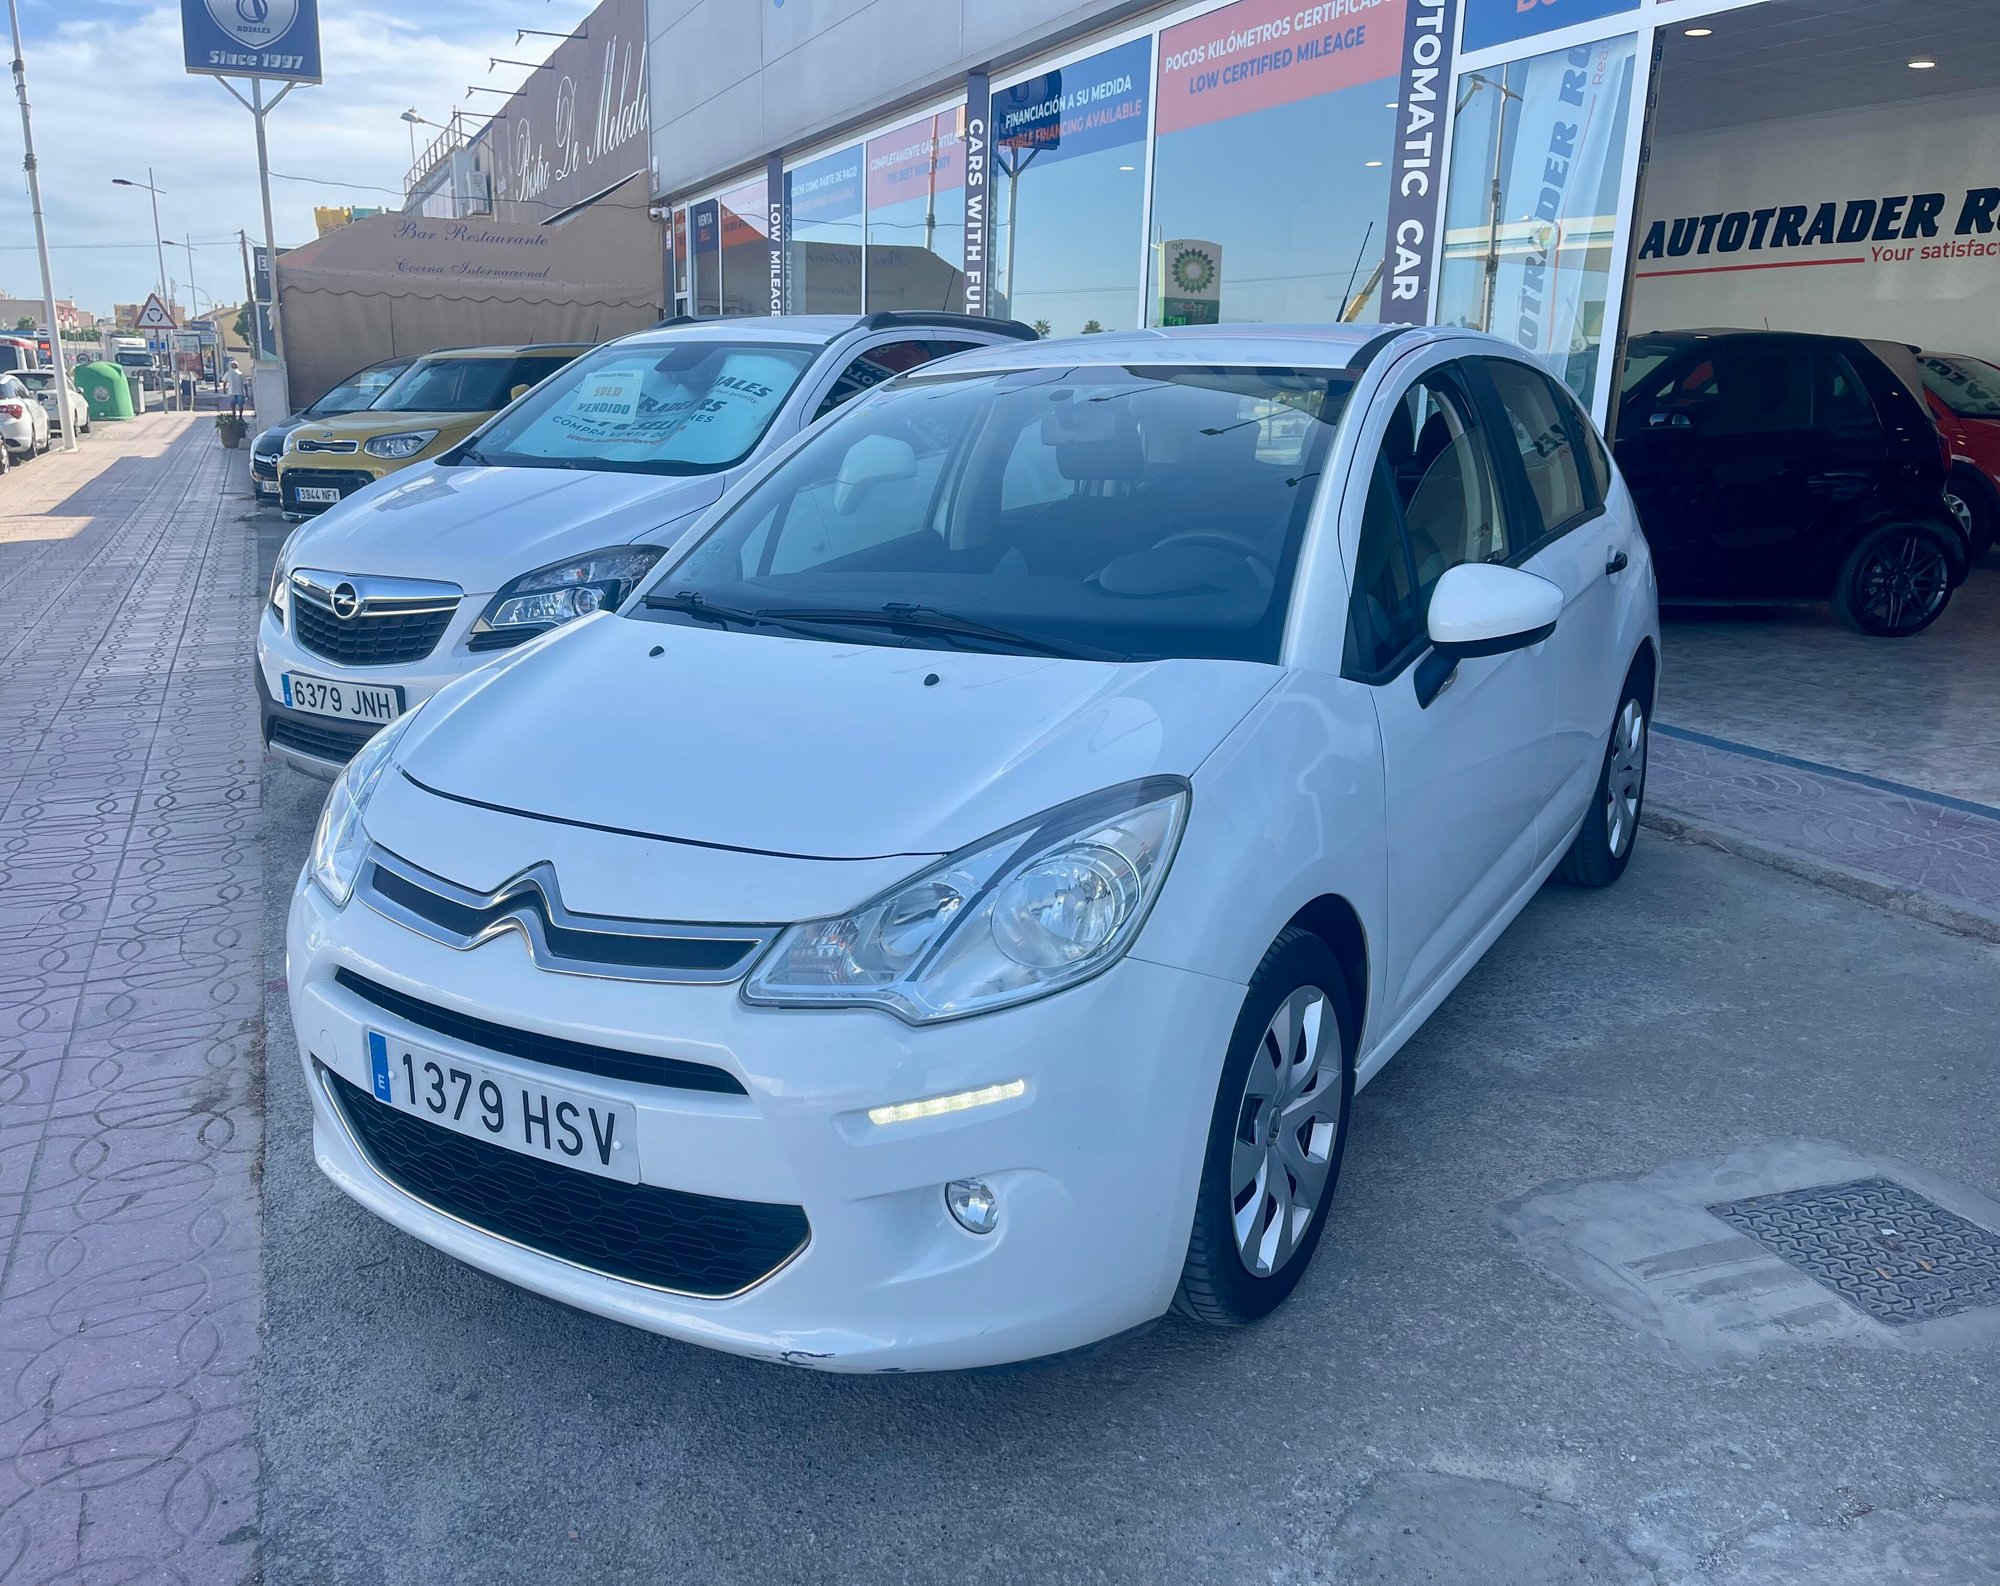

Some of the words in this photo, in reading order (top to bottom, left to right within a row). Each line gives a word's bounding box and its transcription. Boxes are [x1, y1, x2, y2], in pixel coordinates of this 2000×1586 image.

[1165, 45, 1205, 73] POCOS
[1207, 16, 1291, 60] KILÓMETROS
[1294, 0, 1392, 32] CERTIFICA
[209, 50, 257, 67] Since
[262, 53, 304, 70] 1997
[1190, 70, 1220, 95] LOW
[1222, 48, 1293, 85] CERTIFIED
[1297, 25, 1366, 64] MILEAGE
[1006, 94, 1066, 129] FINANCIACIÓN
[1067, 99, 1075, 110] A
[1076, 88, 1089, 107] SU
[1091, 75, 1132, 102] MEDIDA
[1401, 0, 1445, 198] TOMATIC
[516, 118, 549, 202] Bistro
[555, 75, 579, 181] De
[1035, 116, 1083, 143] FINANCING
[1085, 99, 1142, 129] AVAILABLE
[967, 118, 984, 186] CARS
[393, 218, 437, 240] Bar
[444, 221, 548, 246] Restaurante
[697, 212, 713, 227] VENTA
[770, 203, 781, 242] LOW
[966, 195, 983, 261] WITH
[1638, 192, 1946, 260] AUTOTRADER
[1954, 187, 2000, 235] R
[395, 256, 444, 274] Cocina
[451, 260, 550, 278] Internacional
[1391, 219, 1425, 300] CAR
[1871, 244, 1915, 264] Your
[577, 402, 631, 415] VENDIDO
[593, 386, 623, 398] SOLD
[553, 416, 606, 437] COMPRA
[300, 488, 320, 501] 3944
[321, 489, 338, 501] NFY
[294, 680, 342, 712] 6379
[351, 690, 391, 719] JNH
[377, 1074, 386, 1090] E
[402, 1052, 504, 1134] 1379
[522, 1089, 616, 1166] HSV
